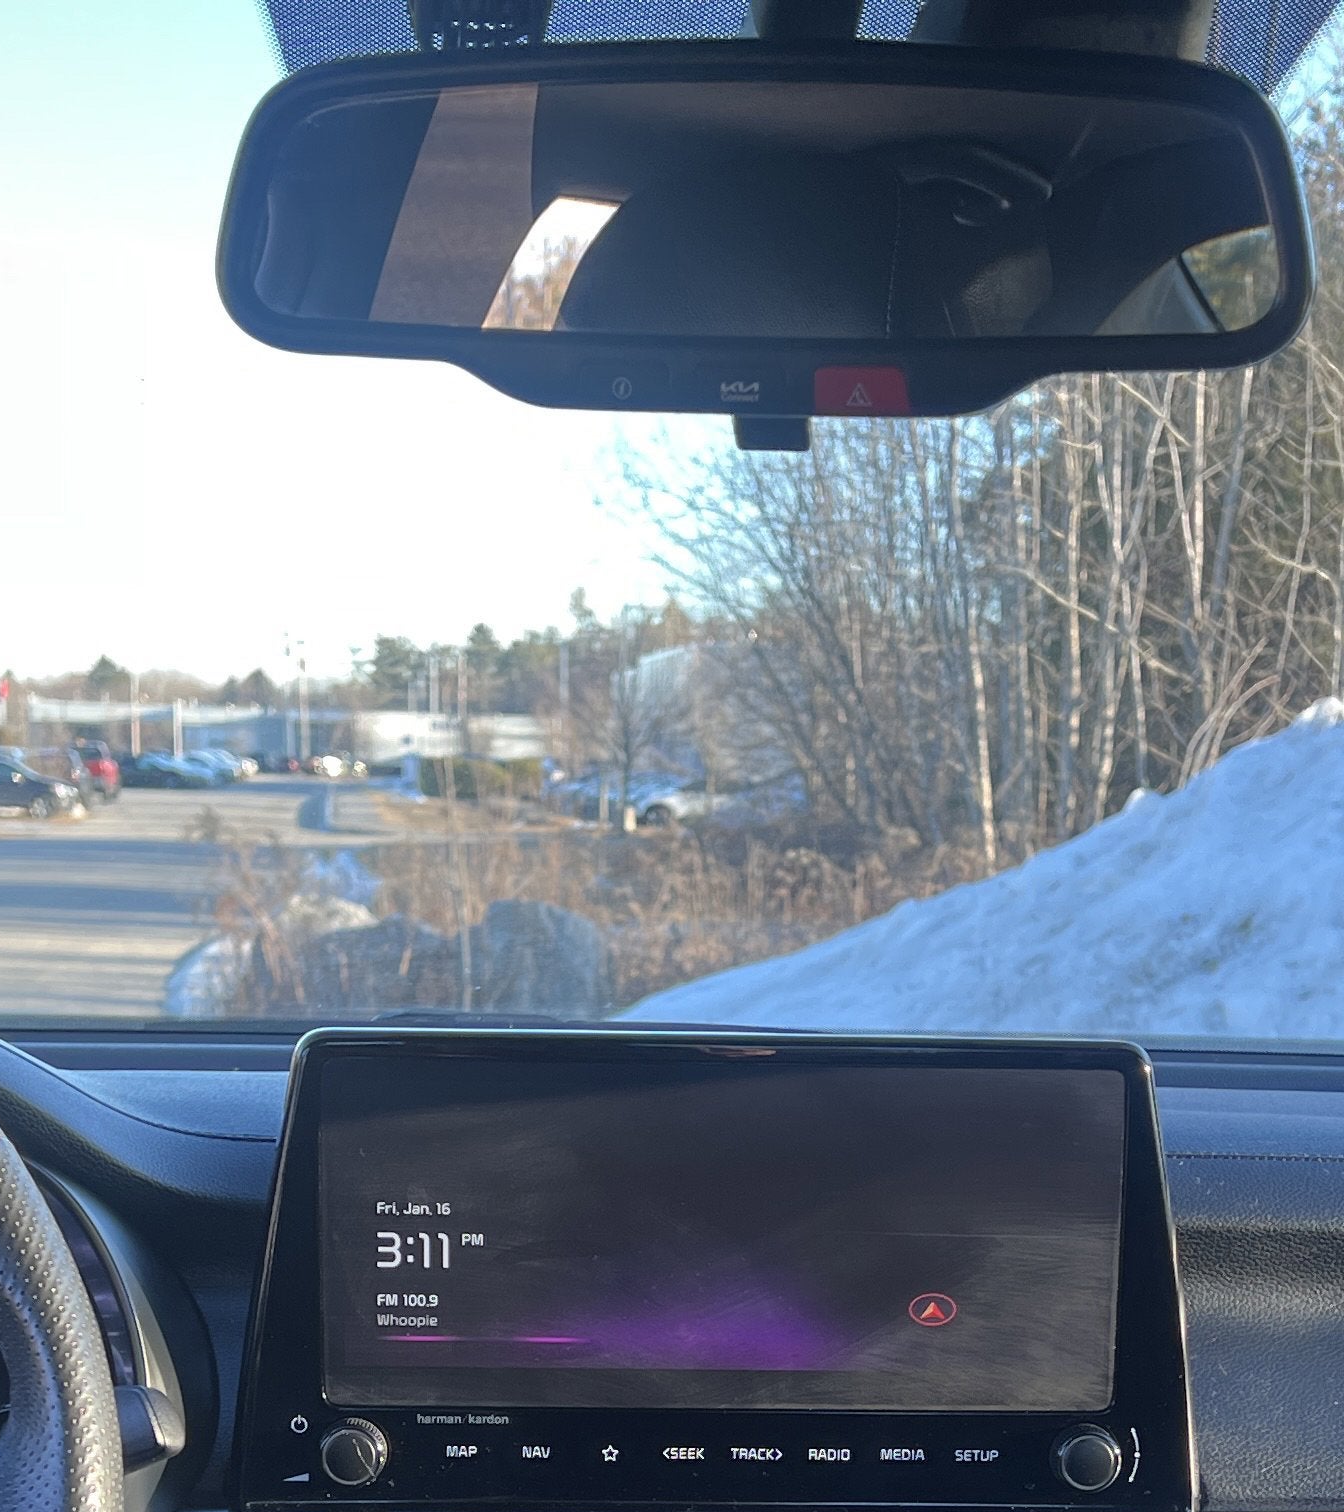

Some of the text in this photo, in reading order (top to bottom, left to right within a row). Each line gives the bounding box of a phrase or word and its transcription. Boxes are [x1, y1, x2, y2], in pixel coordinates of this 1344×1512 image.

[436, 1202, 451, 1215] 16
[376, 1231, 484, 1269] 3:11 PM
[376, 1293, 439, 1307] FM 100.9
[376, 1313, 438, 1328] Whoopie
[446, 1445, 478, 1458] MAP
[522, 1445, 551, 1459] NAV
[808, 1448, 851, 1462] RADIO
[880, 1448, 925, 1461] MEDIA
[955, 1449, 999, 1462] SETUP
